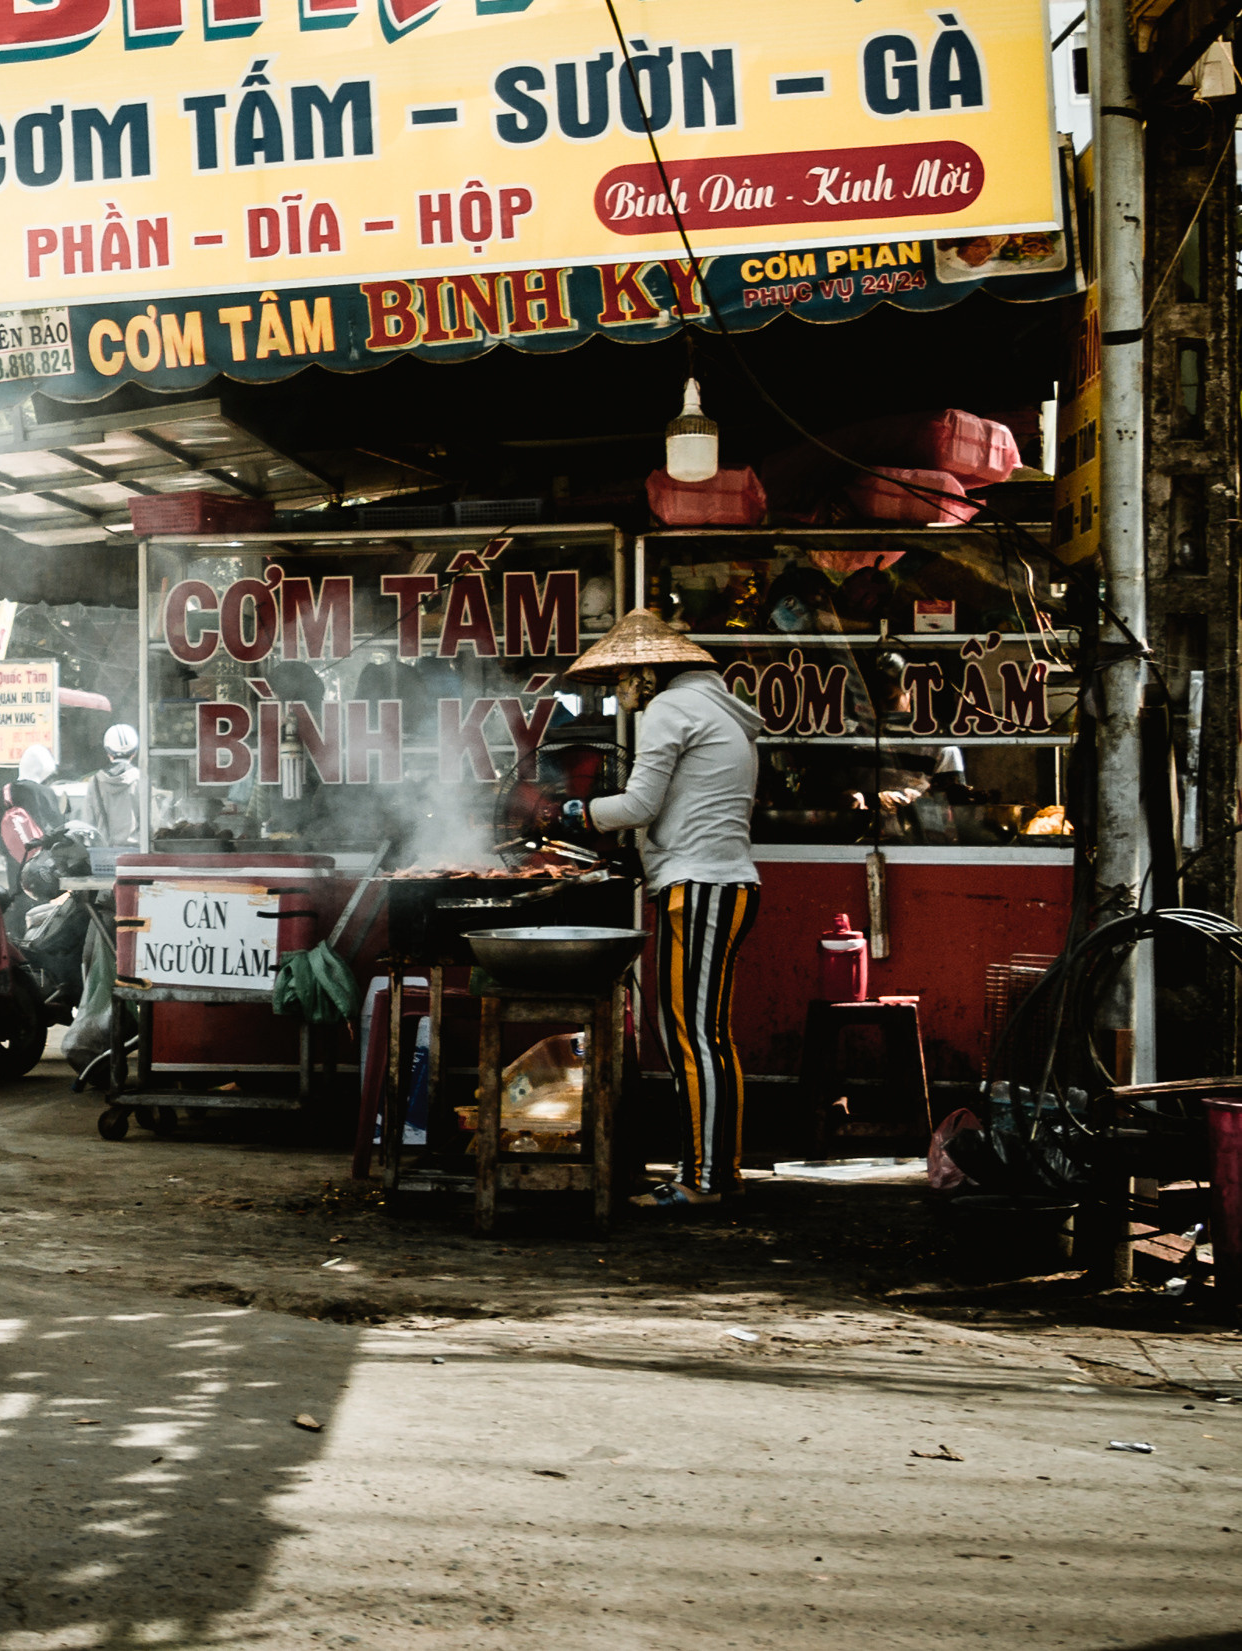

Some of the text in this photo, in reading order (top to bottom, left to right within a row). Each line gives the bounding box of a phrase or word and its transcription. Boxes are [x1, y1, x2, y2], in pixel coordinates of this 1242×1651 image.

[183, 60, 373, 170] TẤM
[495, 40, 737, 144] SƯỜN
[863, 13, 984, 115] GÀ
[605, 177, 690, 221] Bình
[699, 174, 776, 213] Dân
[802, 163, 896, 207] Kính
[902, 158, 972, 200] Mời
[26, 203, 169, 278] PHẦN
[247, 193, 342, 258] DĨA
[419, 180, 533, 253] HỘP
[740, 251, 817, 283] CƠM
[742, 270, 927, 310] PHỤC VỤ 24/24
[28, 315, 68, 347] BẢO
[88, 304, 206, 377] CƠM
[163, 537, 580, 665] CƠM TẤM
[900, 630, 1050, 736] TẤM
[196, 673, 559, 787] BÌNH KÝ
[144, 936, 271, 978] NGƯỜI LÀM
